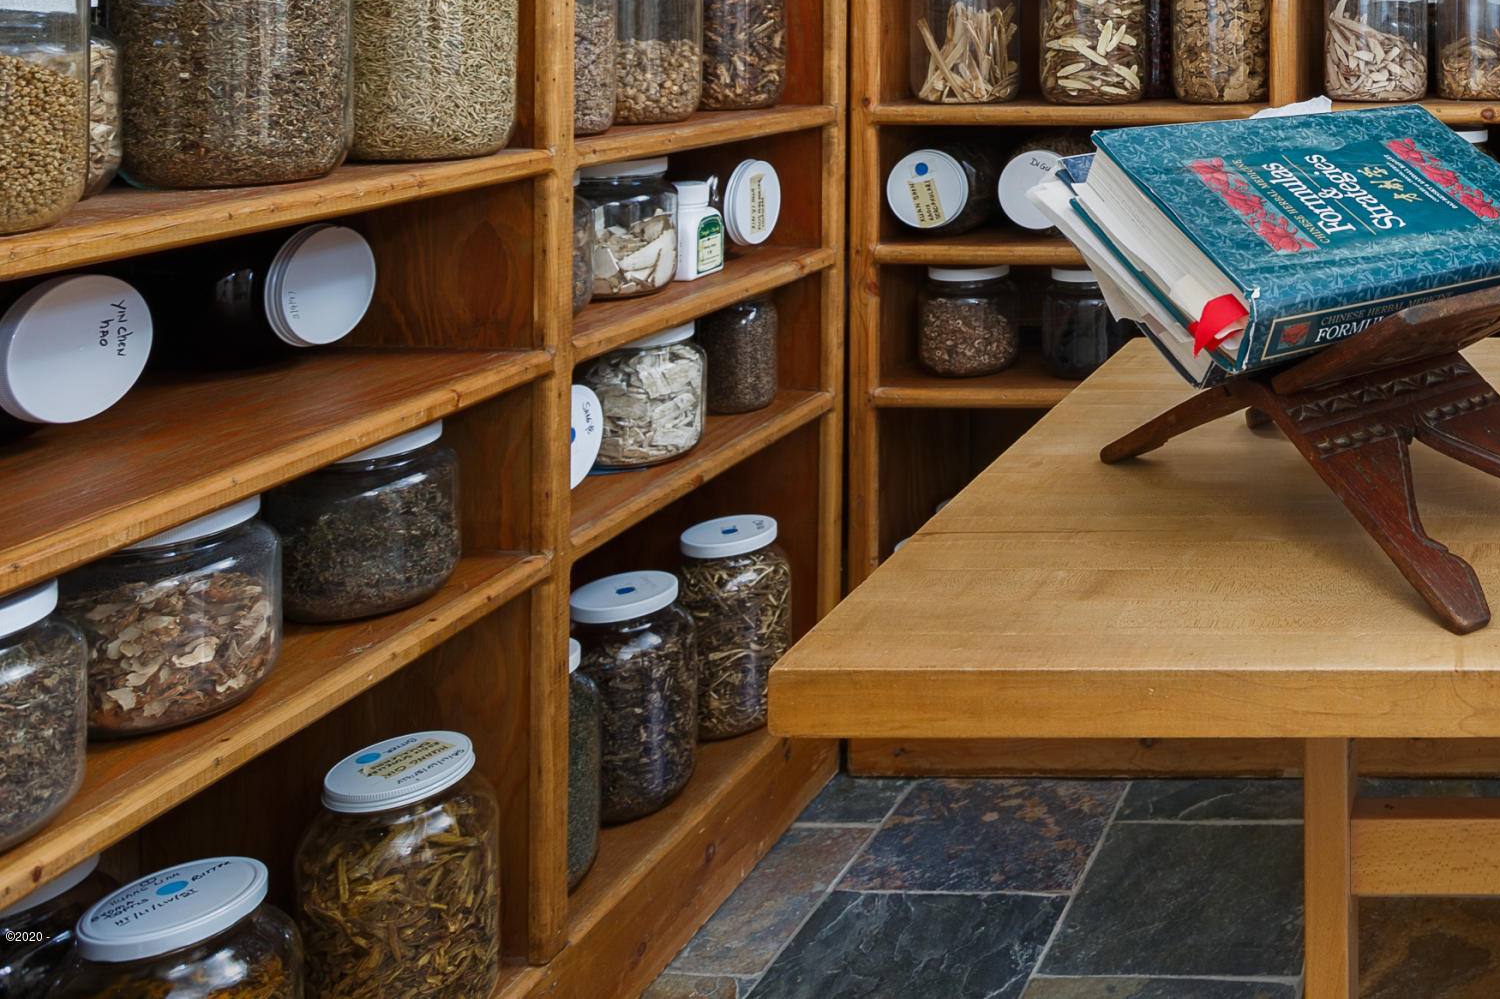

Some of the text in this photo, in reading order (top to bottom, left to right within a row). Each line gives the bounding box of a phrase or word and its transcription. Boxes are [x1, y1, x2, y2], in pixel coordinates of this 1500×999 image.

[1231, 159, 1331, 245] CHINESE HERBAL MEDICINE
[1261, 162, 1357, 235] Formulas
[1304, 154, 1407, 230] Strategies
[1319, 186, 1344, 200] &
[110, 299, 128, 323] YIN
[1320, 308, 1366, 326] CHINESE
[1366, 302, 1404, 318] HERBAL
[409, 745, 449, 766] HUANG
